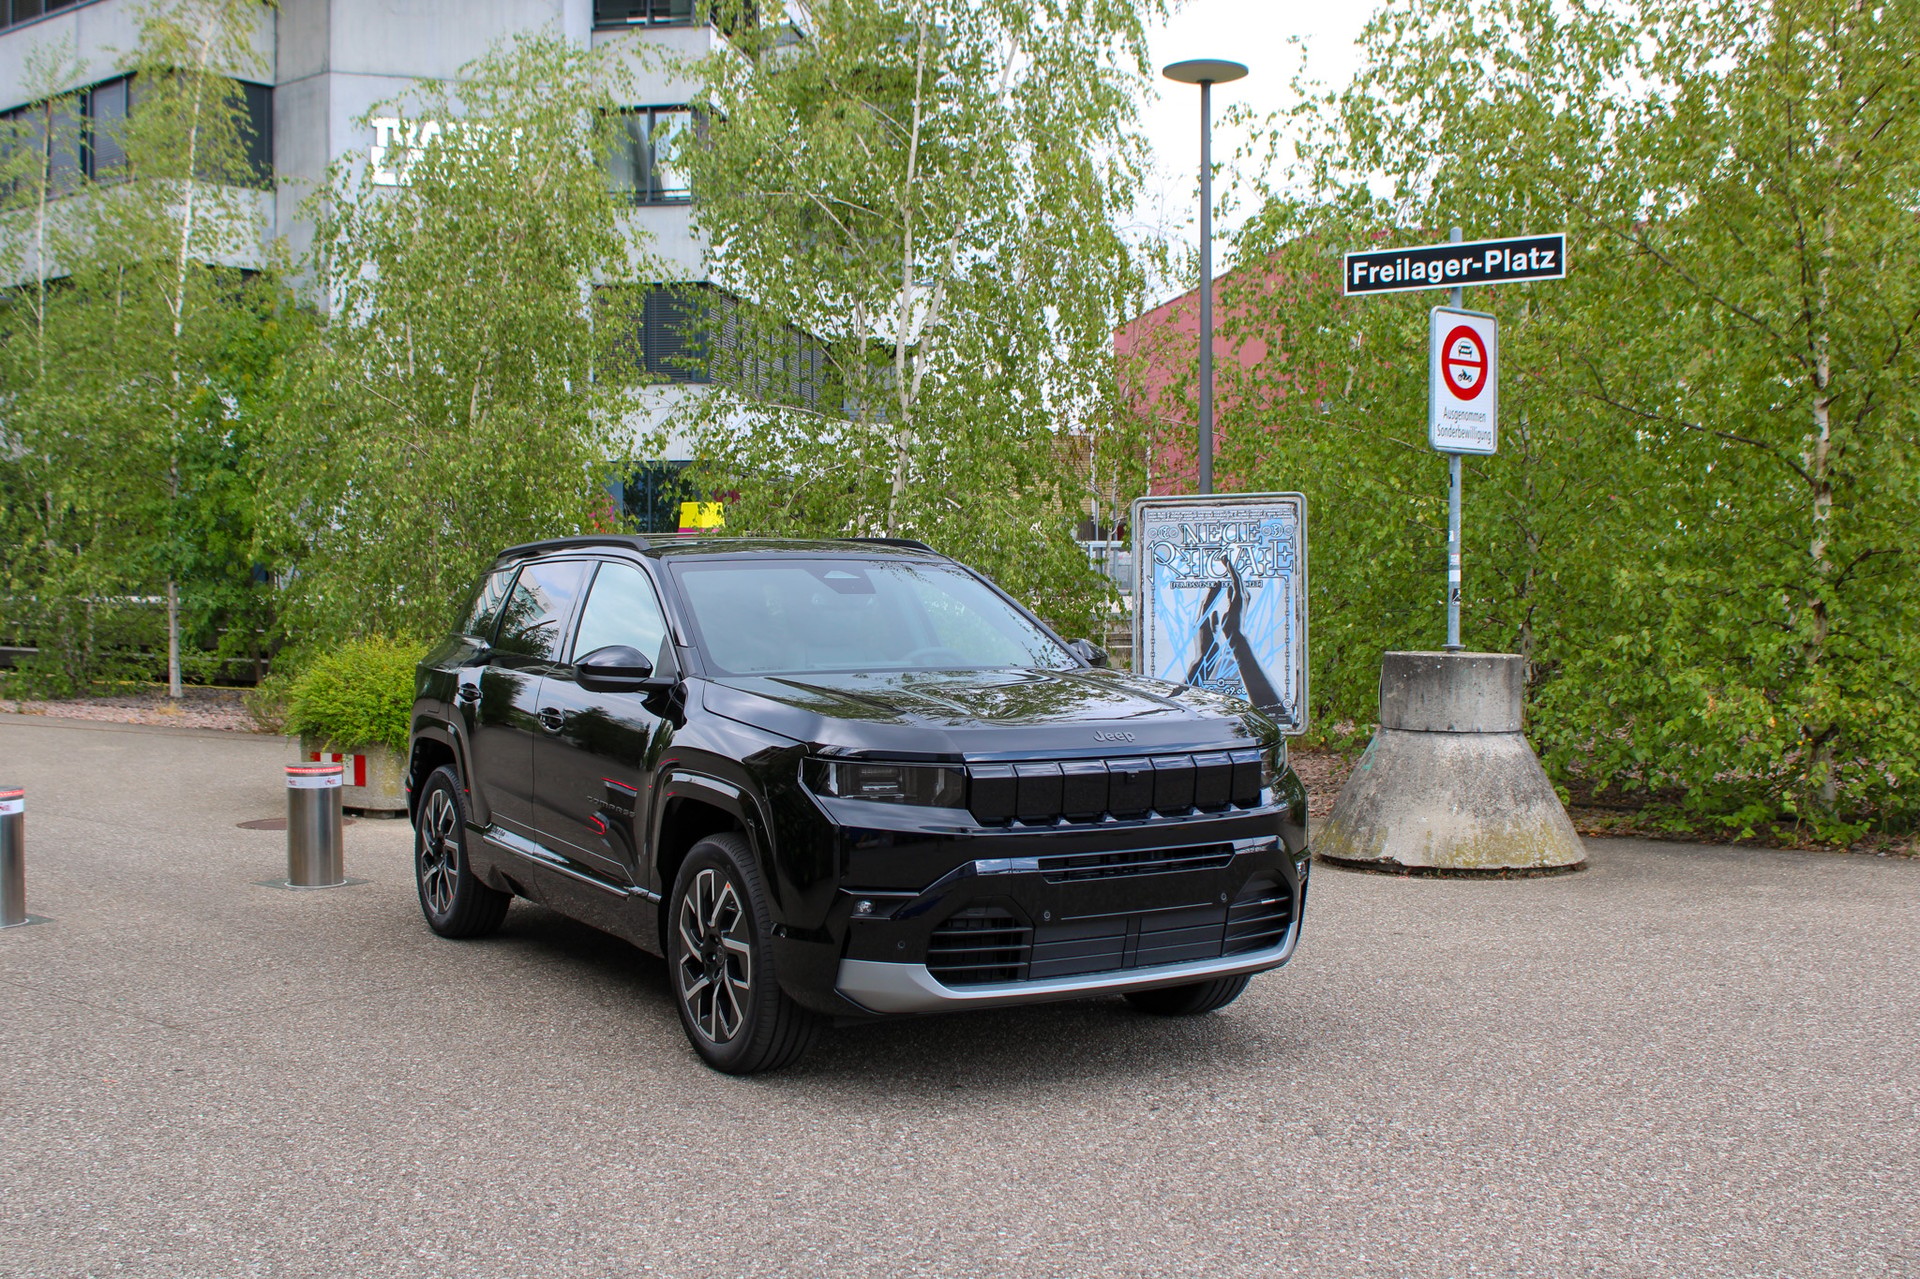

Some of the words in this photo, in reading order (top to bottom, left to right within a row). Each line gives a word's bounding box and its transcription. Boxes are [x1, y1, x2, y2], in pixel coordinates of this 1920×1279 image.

[1353, 247, 1556, 284] Freilager-Platz
[1443, 406, 1486, 423] Ausgenommen
[1437, 423, 1491, 445] Sonderbewilligung
[1178, 520, 1262, 545] NEUE
[1147, 537, 1294, 585] RITUALE
[1093, 730, 1136, 743] Jeep
